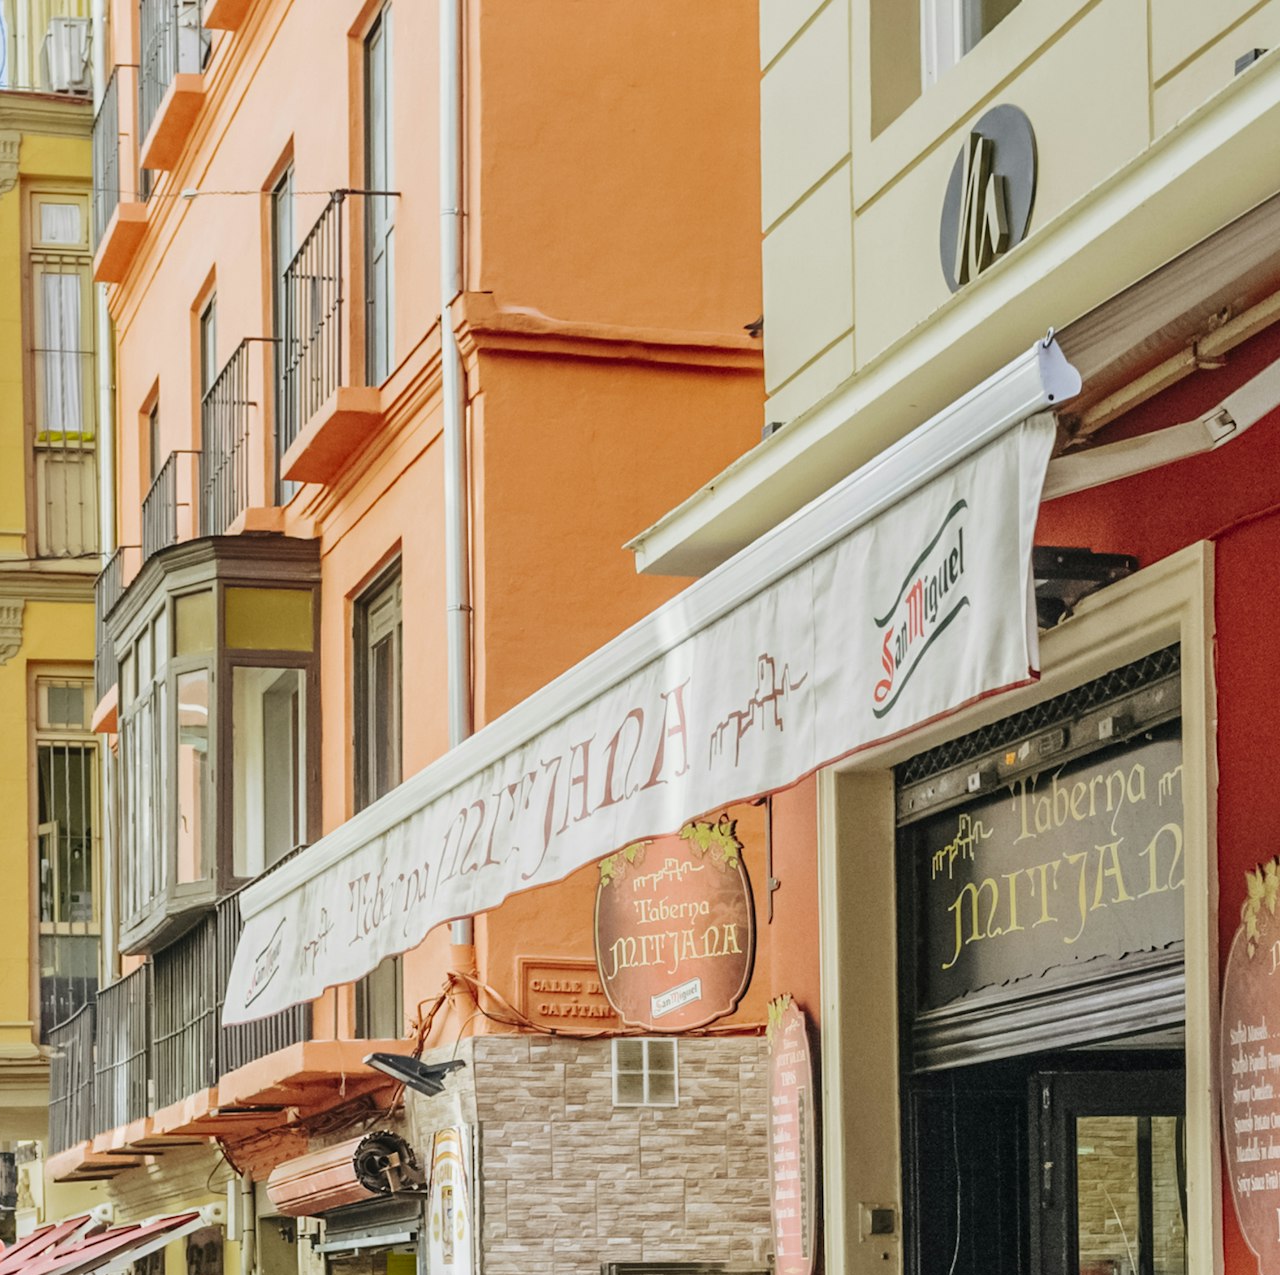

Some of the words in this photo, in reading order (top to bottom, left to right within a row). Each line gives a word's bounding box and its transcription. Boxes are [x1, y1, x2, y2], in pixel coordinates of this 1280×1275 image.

[427, 676, 693, 903] MITJANA
[1009, 761, 1147, 846] Taberna
[633, 896, 710, 925] Taberna
[607, 922, 743, 980] MITJANA
[530, 981, 582, 993] CALLE
[587, 982, 604, 994] D
